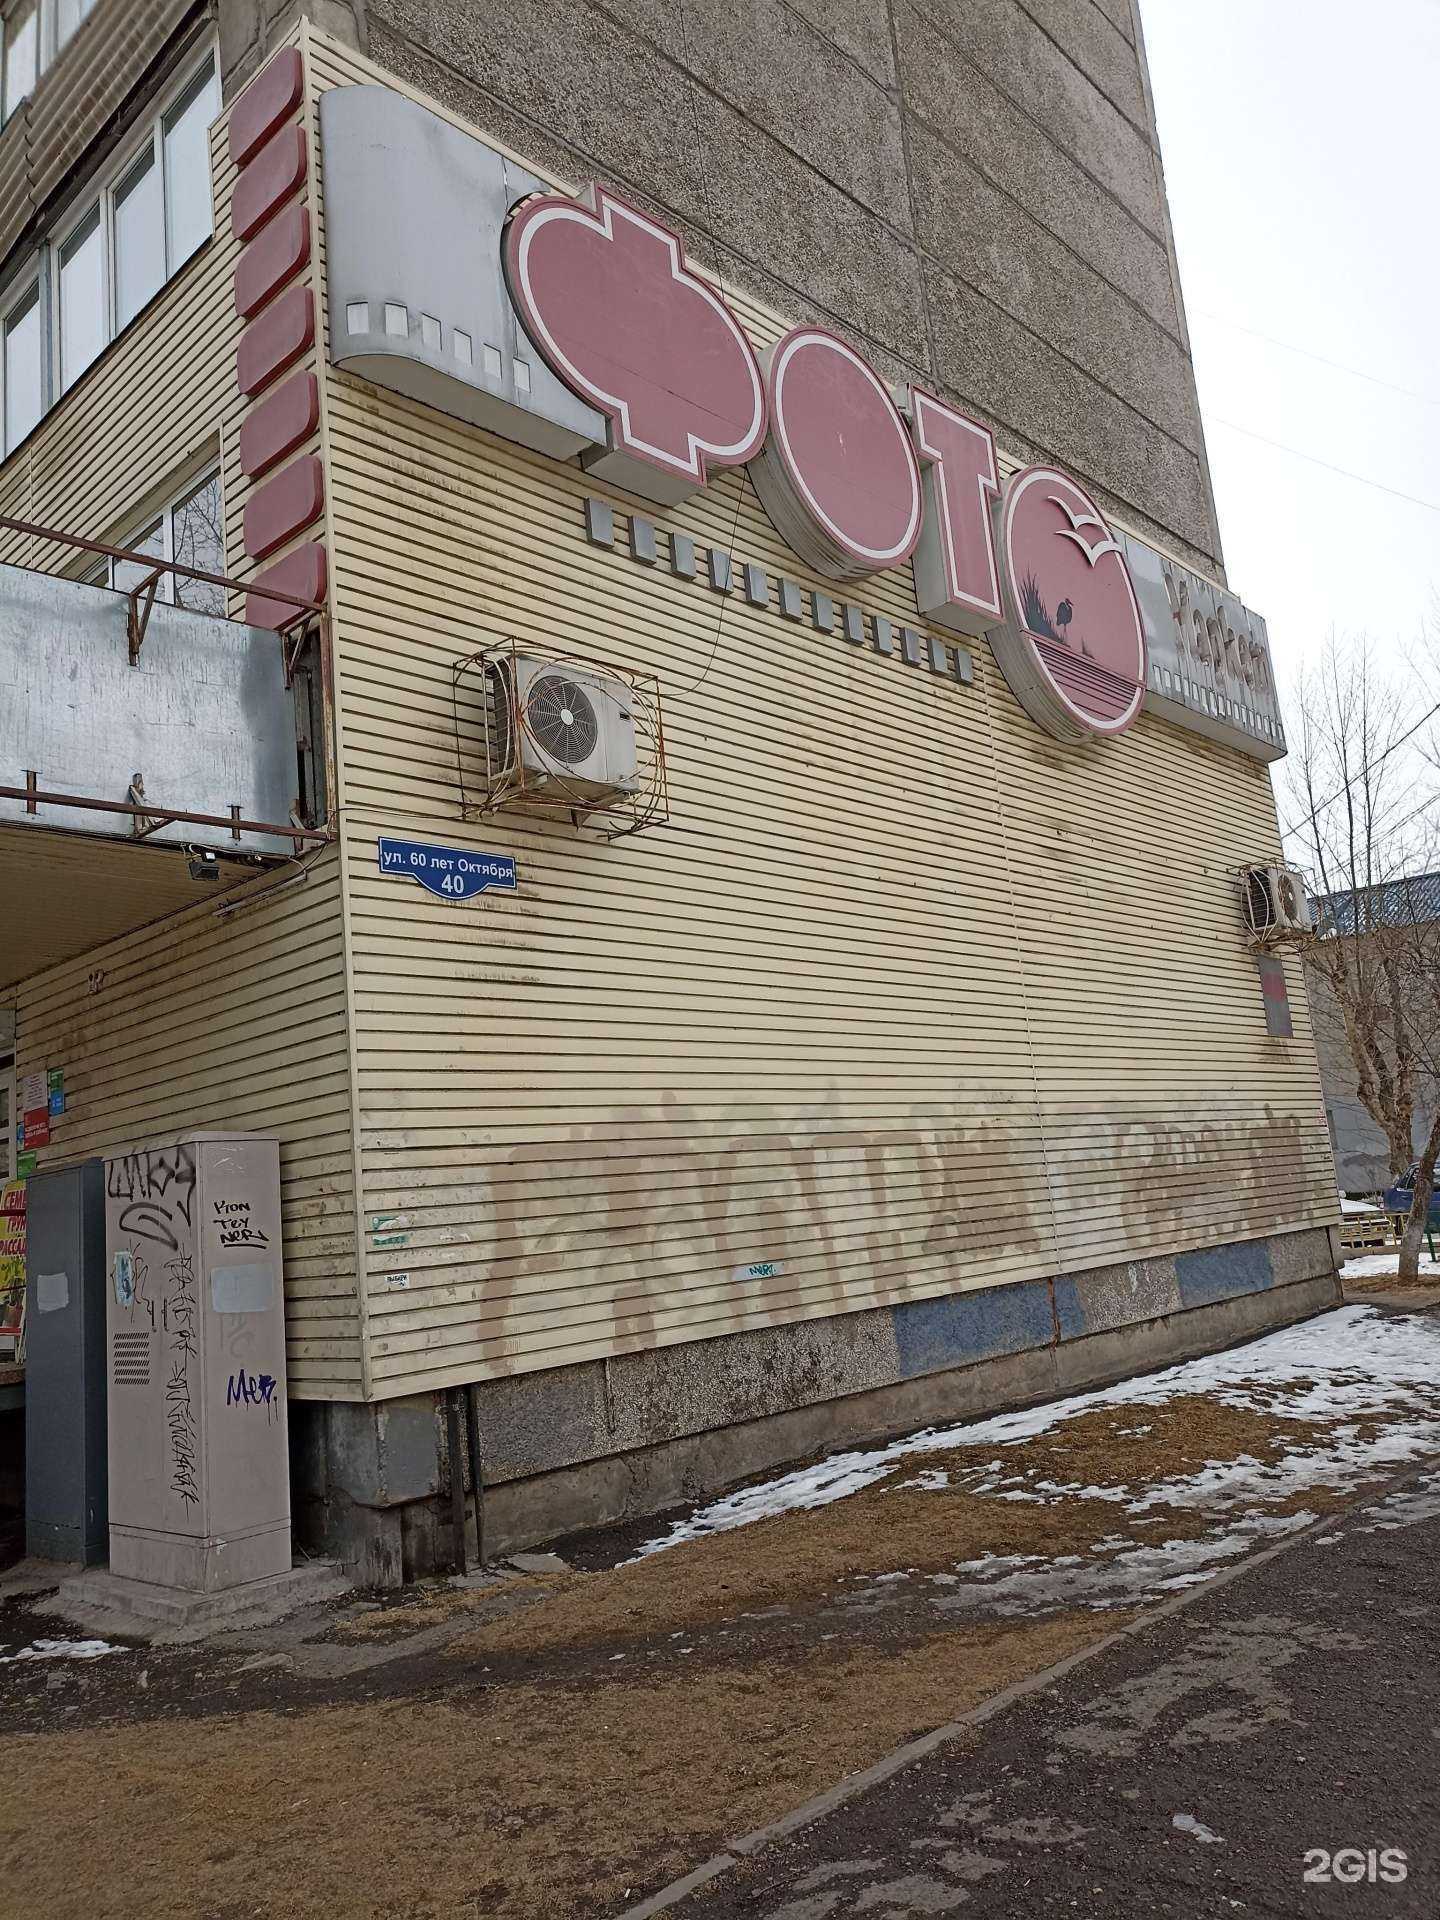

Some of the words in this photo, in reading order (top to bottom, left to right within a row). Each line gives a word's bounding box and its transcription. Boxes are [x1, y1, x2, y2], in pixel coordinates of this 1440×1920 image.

[384, 851, 406, 865] ул.
[410, 852, 426, 867] 60
[430, 857, 454, 871] лет
[458, 858, 513, 879] Октября
[441, 874, 464, 894] 40
